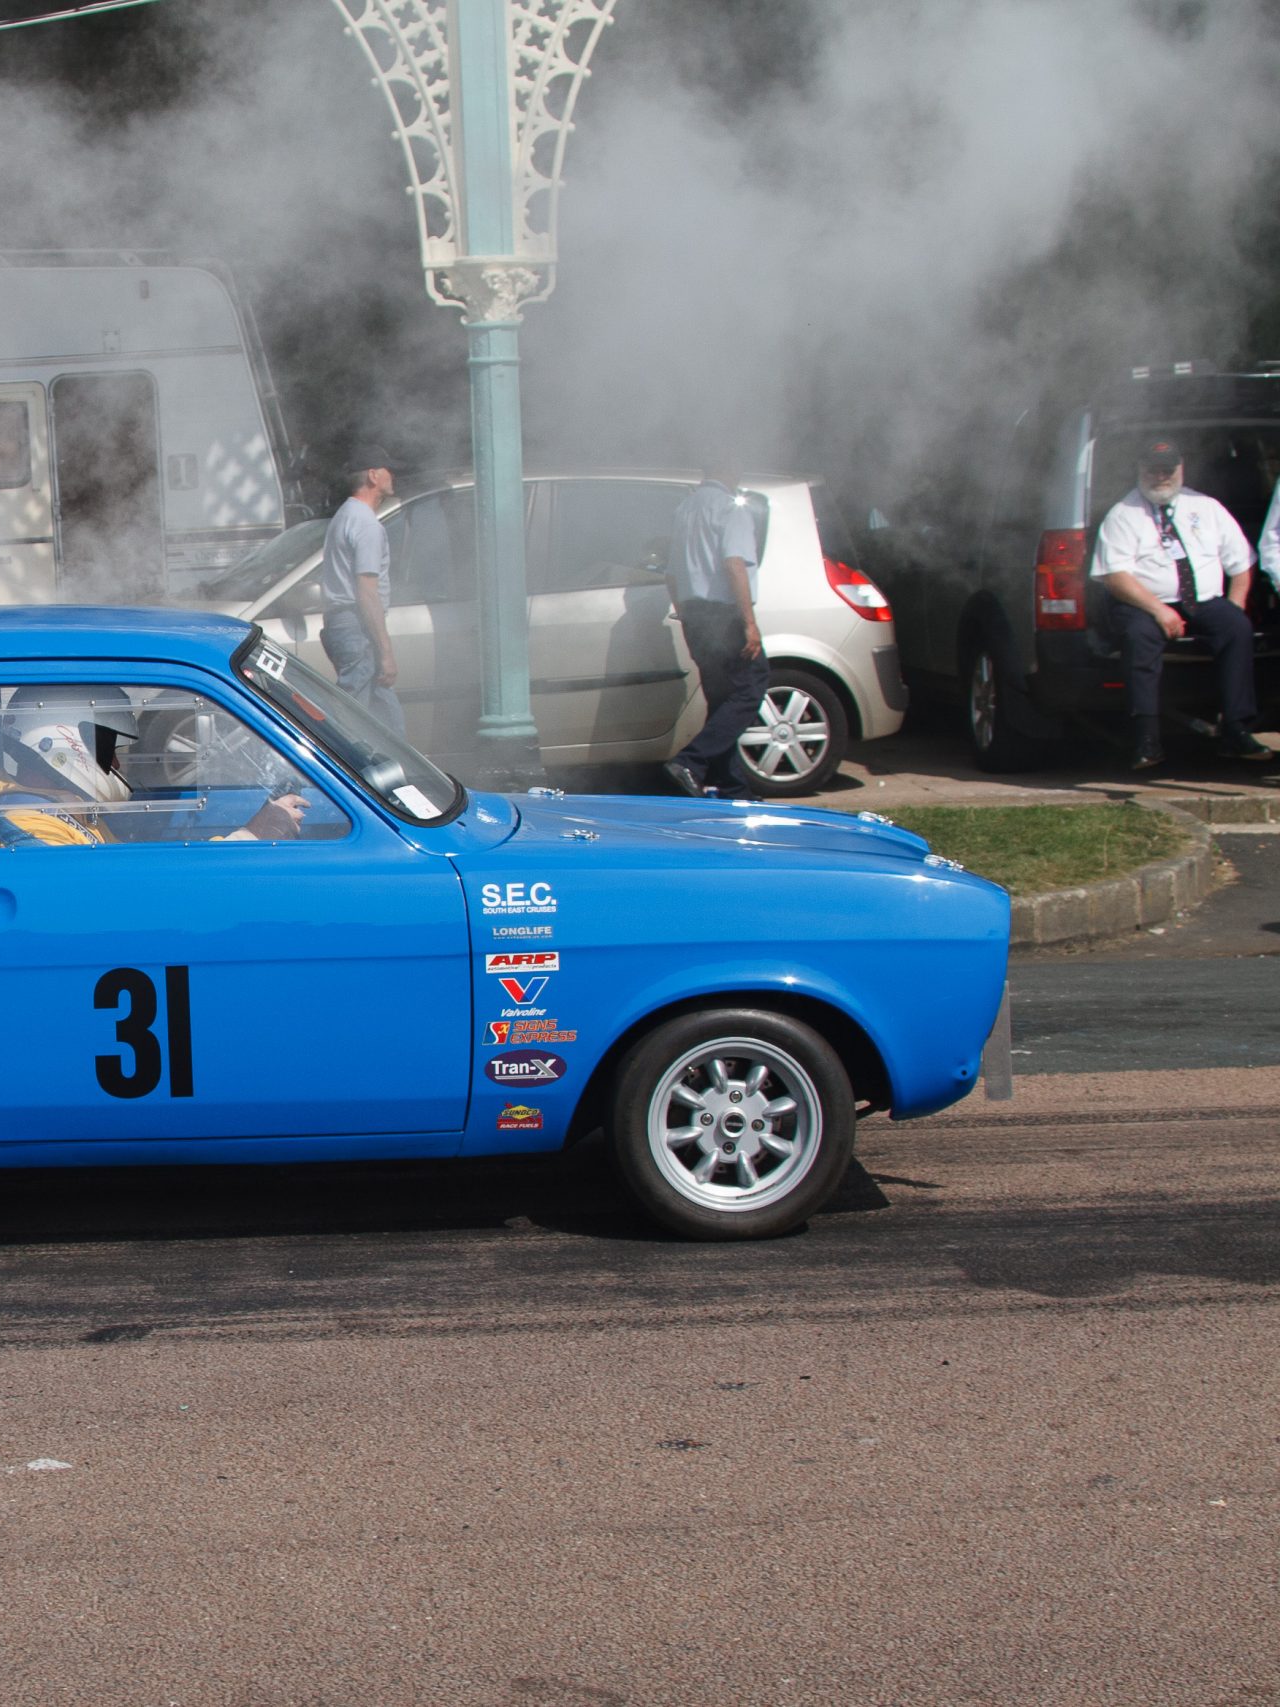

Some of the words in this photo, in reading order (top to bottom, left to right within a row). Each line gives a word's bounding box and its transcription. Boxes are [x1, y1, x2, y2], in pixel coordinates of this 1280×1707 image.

[481, 882, 557, 907] S.E.C.
[508, 906, 525, 914] EAST
[492, 926, 552, 936] LONGLIFE
[488, 953, 557, 967] ARP
[500, 1008, 548, 1017] Valvoline
[94, 965, 194, 1099] 31
[513, 1019, 558, 1032] SIGNS
[510, 1030, 577, 1045] EXPRESS
[491, 1059, 559, 1078] Tran-X
